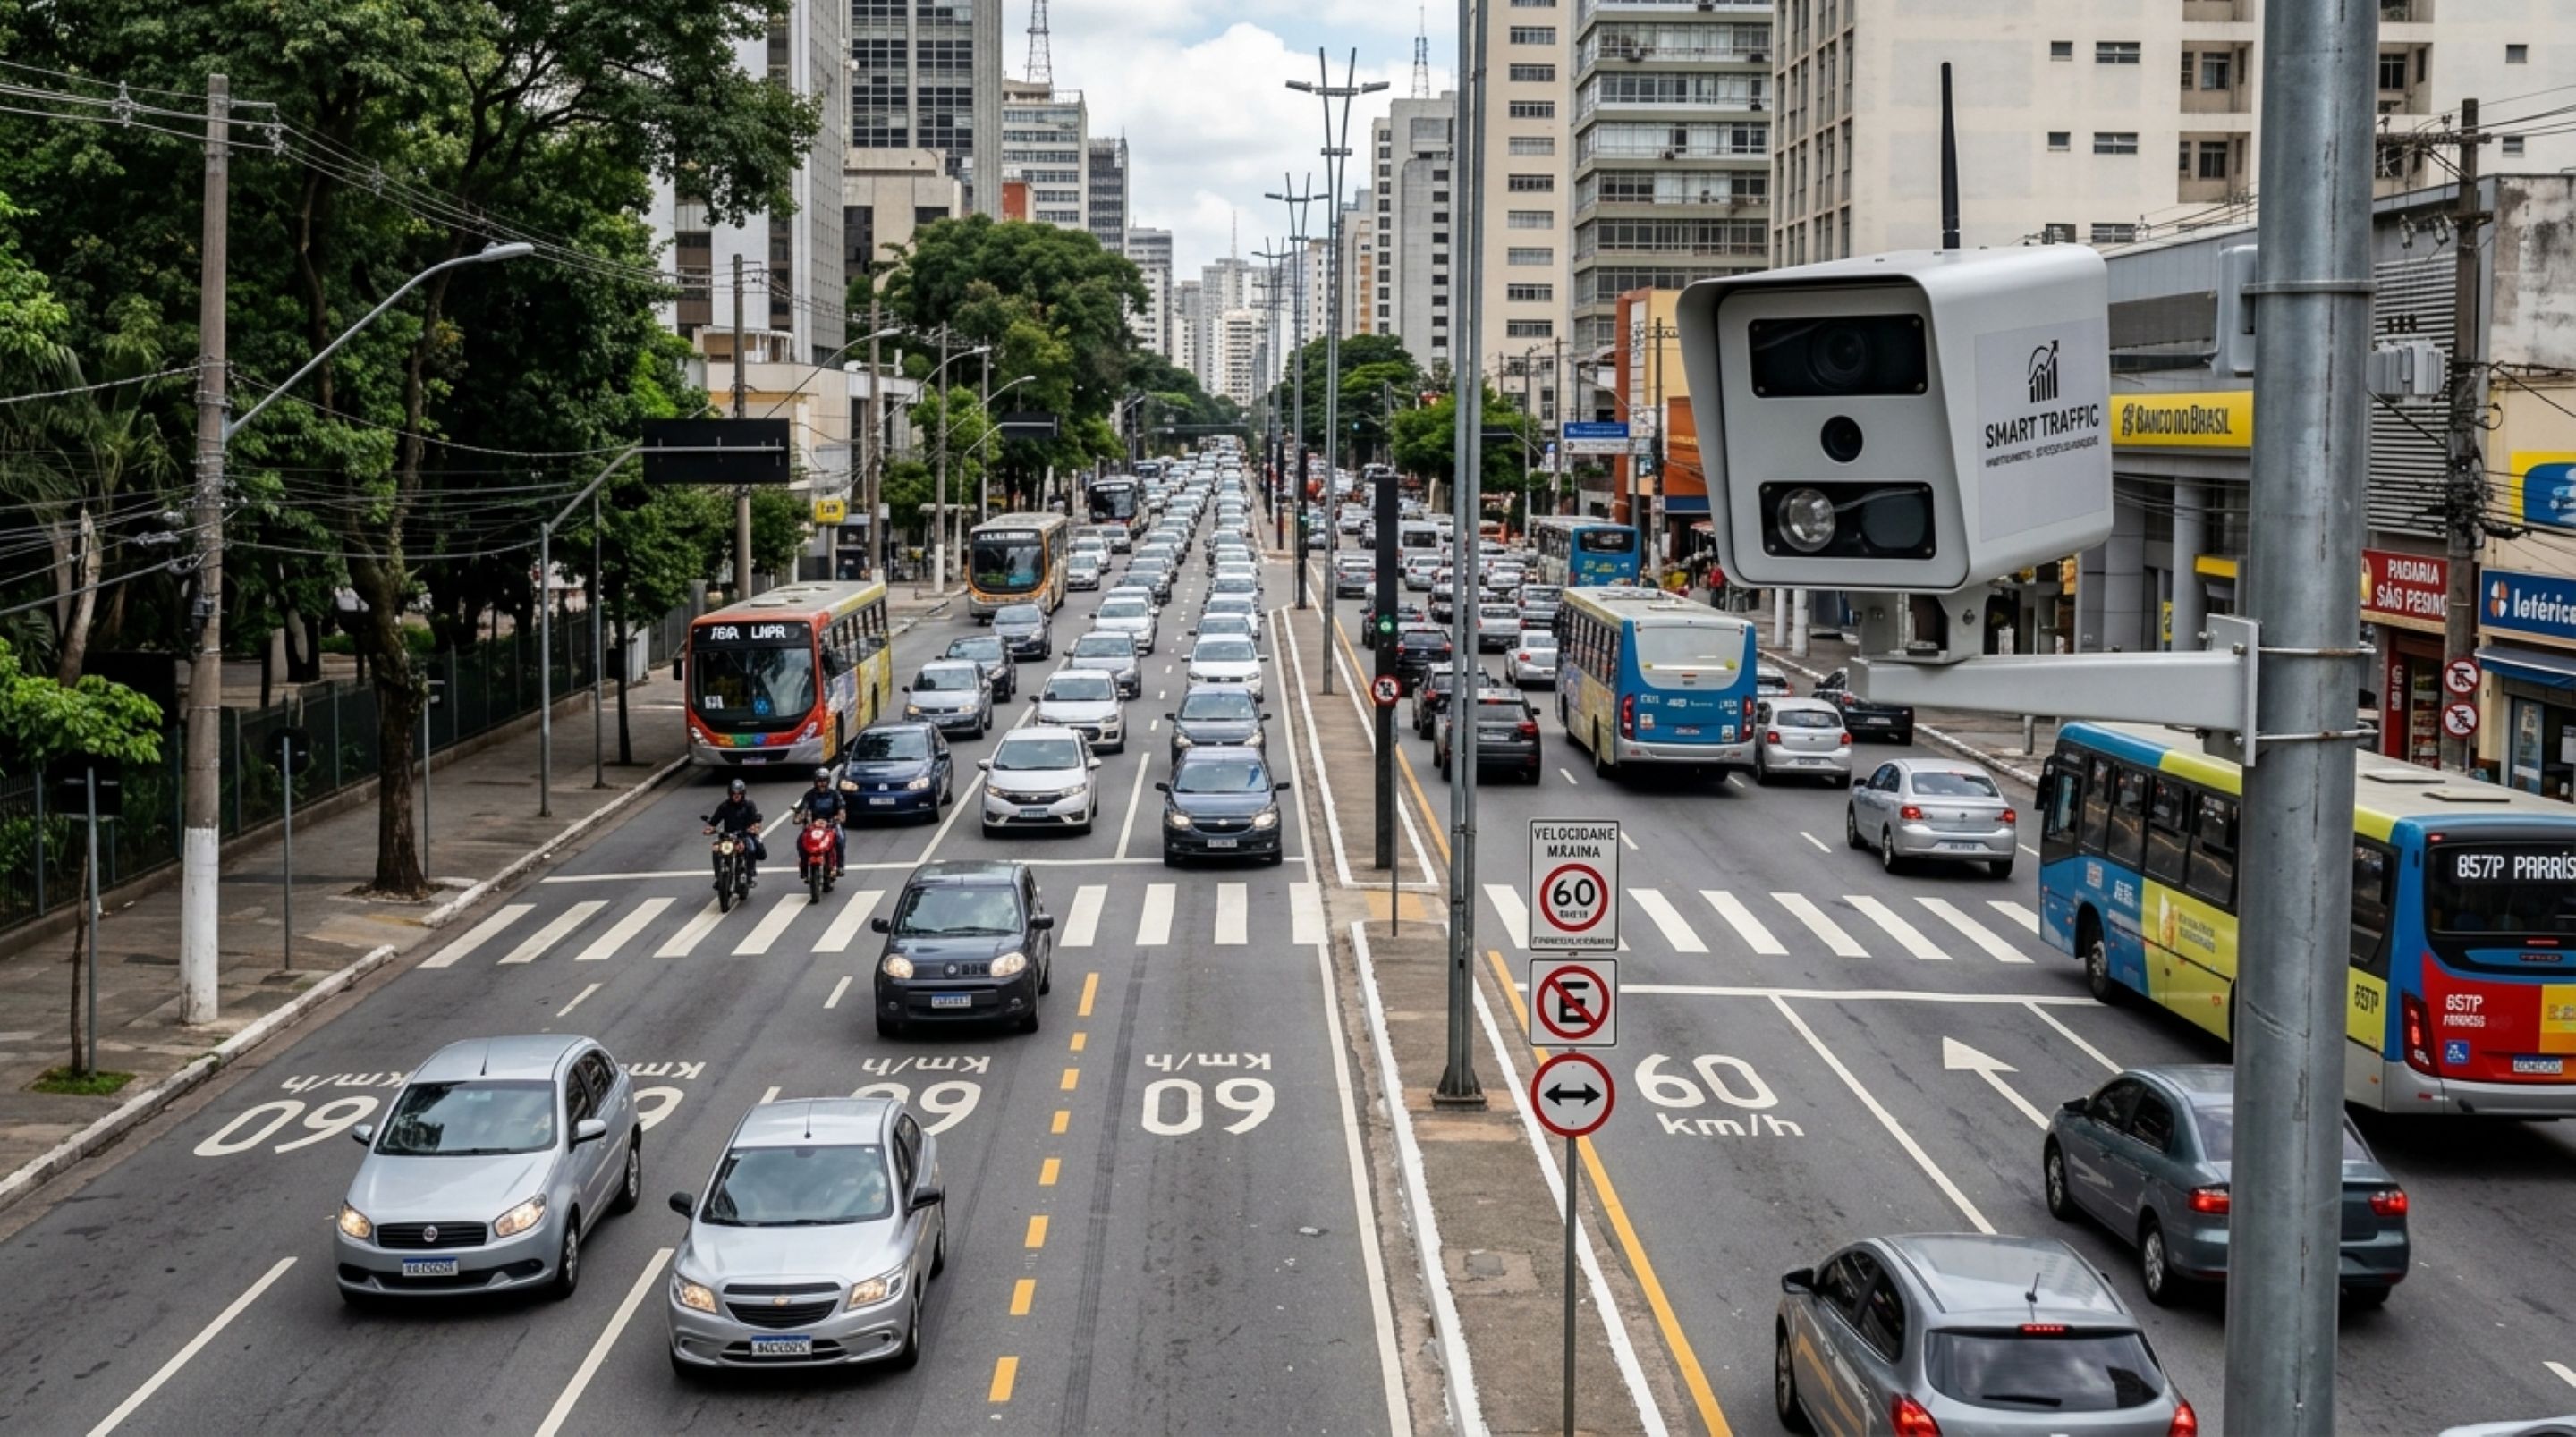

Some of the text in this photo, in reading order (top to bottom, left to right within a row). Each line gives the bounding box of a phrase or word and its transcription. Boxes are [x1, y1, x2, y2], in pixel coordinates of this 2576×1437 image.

[1985, 403, 2099, 449] SMART TRAFFIC
[1552, 878, 1596, 907] 60
[1141, 1077, 1275, 1136] 60
[1635, 1054, 1780, 1110] 60
[193, 1095, 379, 1156] 60
[1655, 1112, 1806, 1137] km/h
